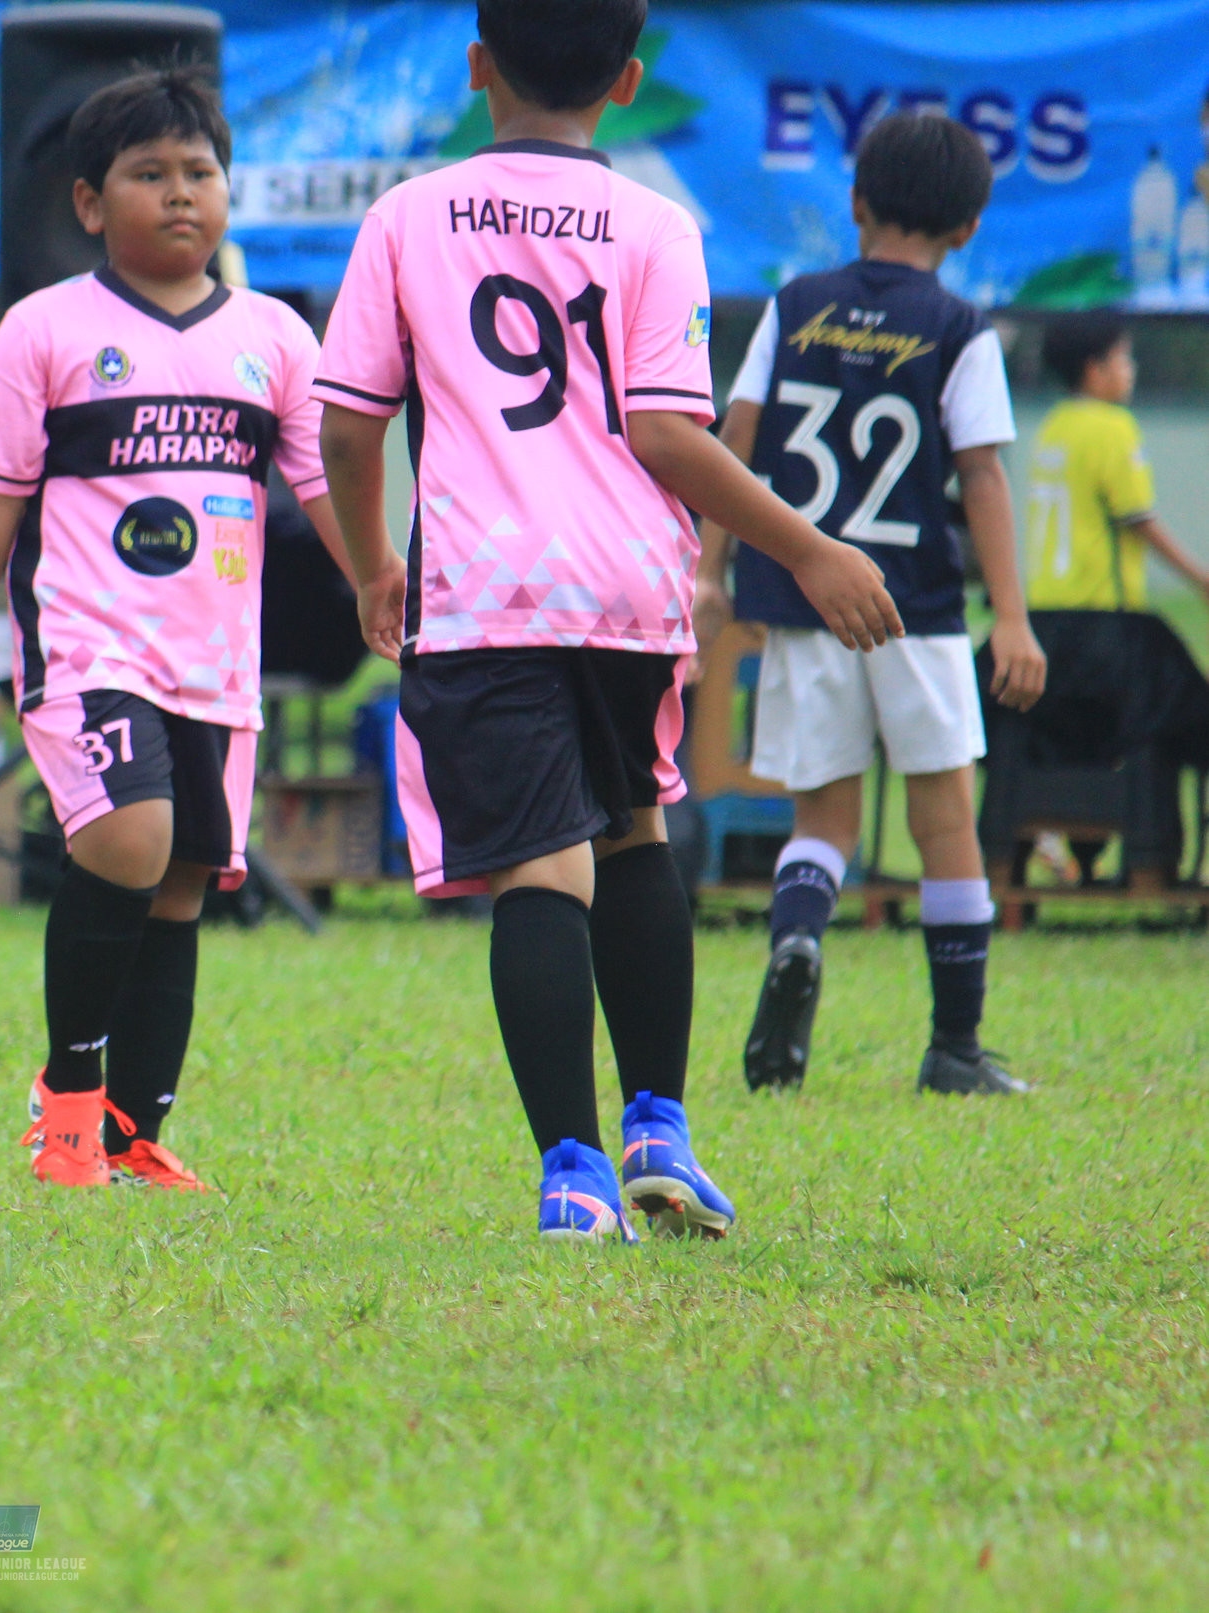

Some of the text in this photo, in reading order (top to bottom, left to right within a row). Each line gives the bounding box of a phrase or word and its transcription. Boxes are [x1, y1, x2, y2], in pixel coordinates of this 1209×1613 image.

[449, 197, 615, 243] HAFIDZUL
[470, 273, 624, 435] 91
[131, 403, 240, 436] PUTRA
[755, 379, 921, 548] 32
[73, 717, 134, 776] 37
